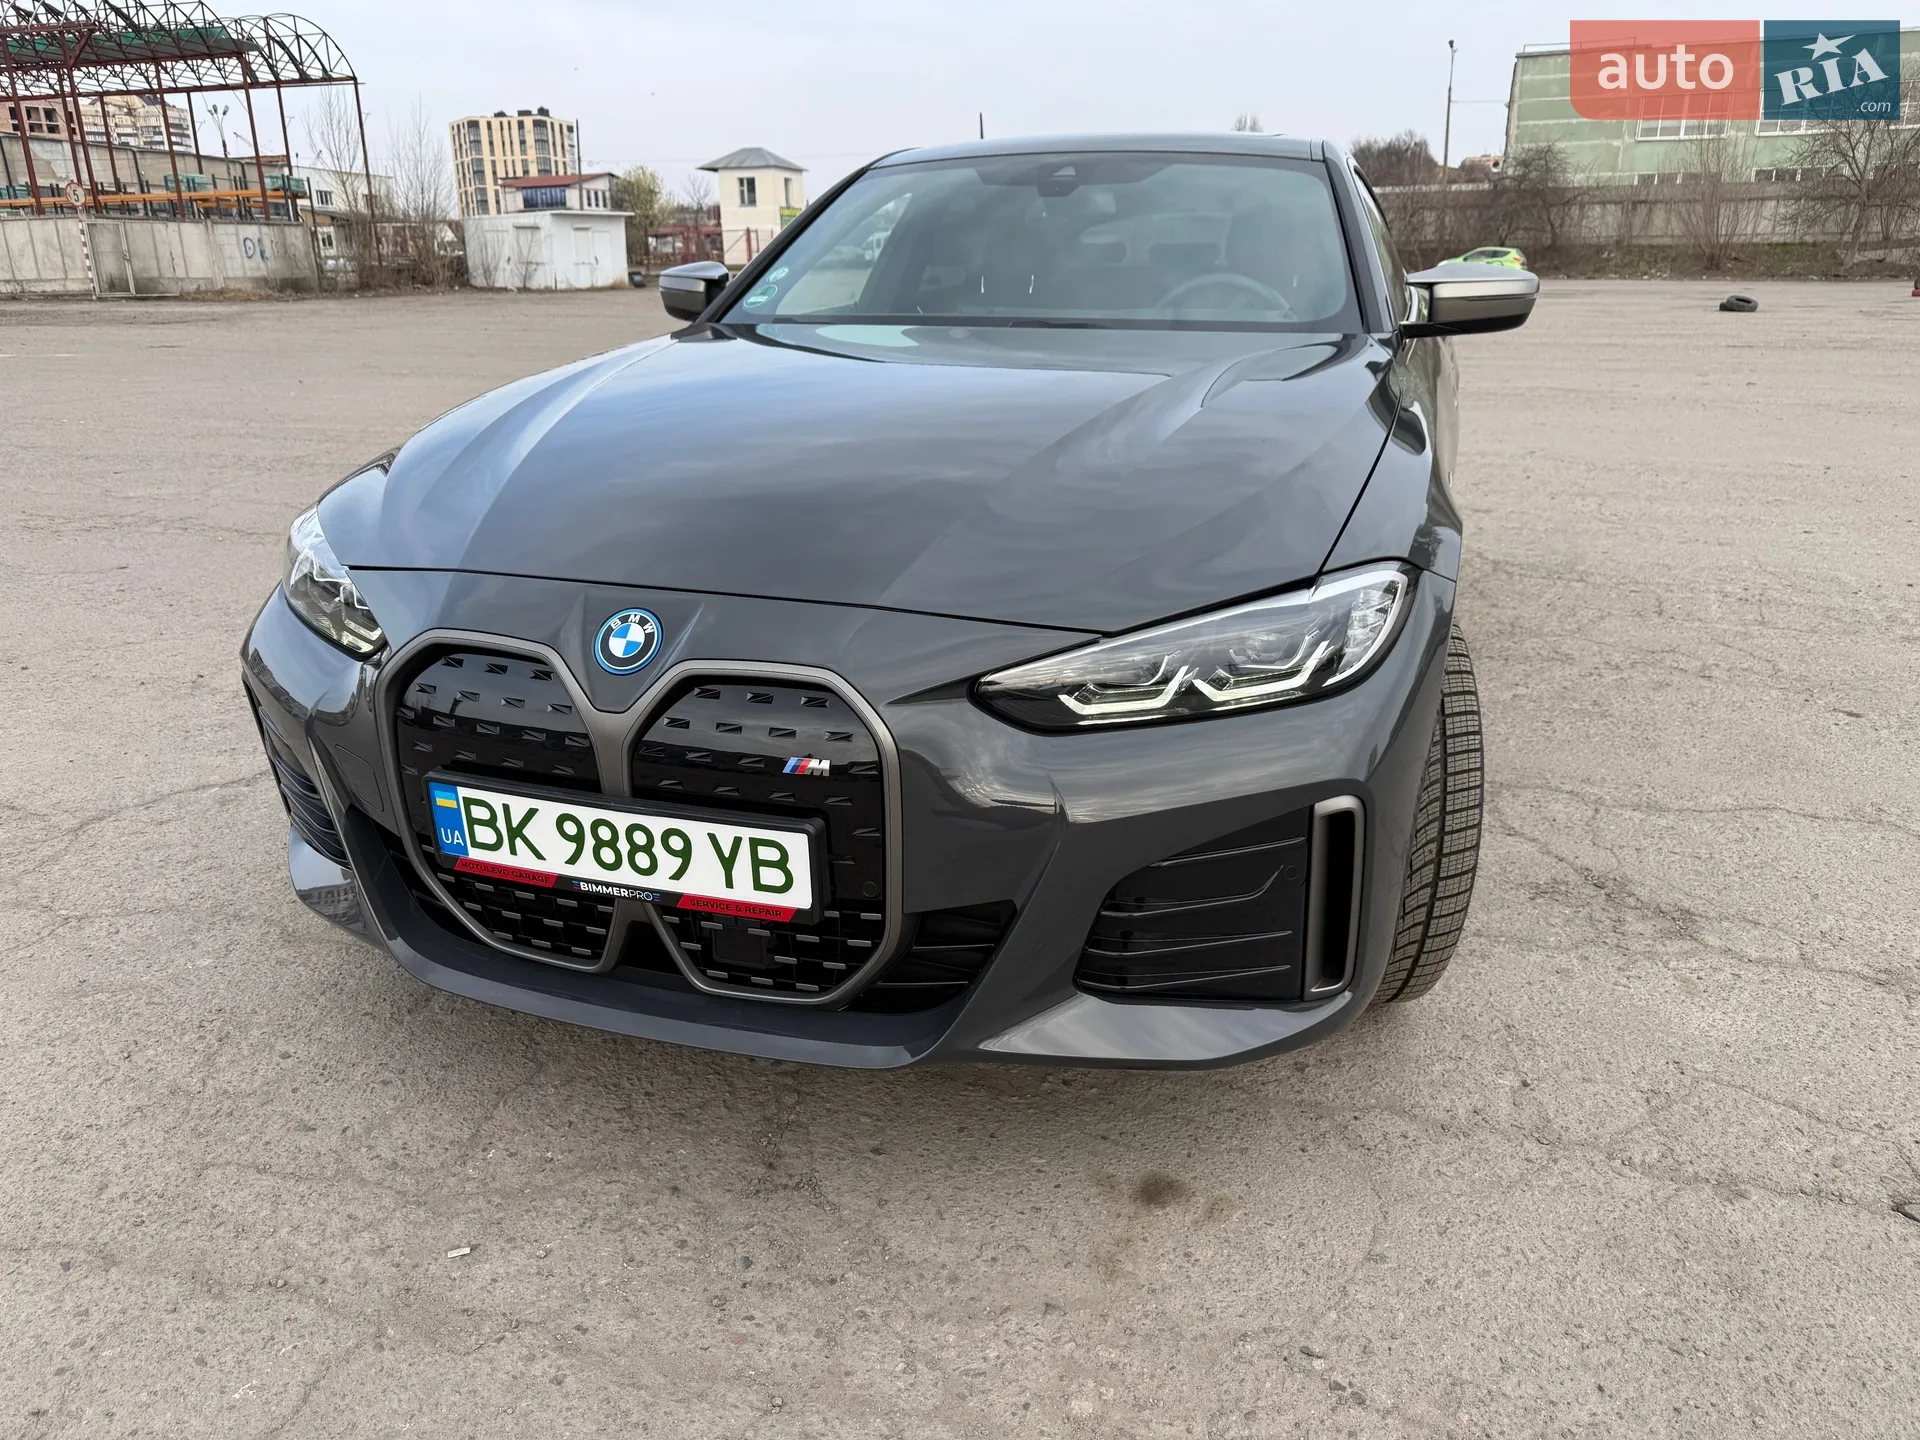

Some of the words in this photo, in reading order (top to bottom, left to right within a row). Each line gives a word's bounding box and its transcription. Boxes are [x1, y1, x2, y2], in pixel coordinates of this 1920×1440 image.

[72, 189, 80, 202] 5
[610, 613, 655, 634] BMW
[441, 828, 465, 847] UA
[462, 796, 547, 861] BK
[555, 812, 692, 881] 9889
[707, 832, 794, 894] YB
[511, 870, 551, 884] GARAGE
[580, 881, 653, 901] BIMMERPRO
[690, 899, 733, 911] SERVICE
[735, 904, 742, 913] &
[745, 905, 782, 917] REPAIR
